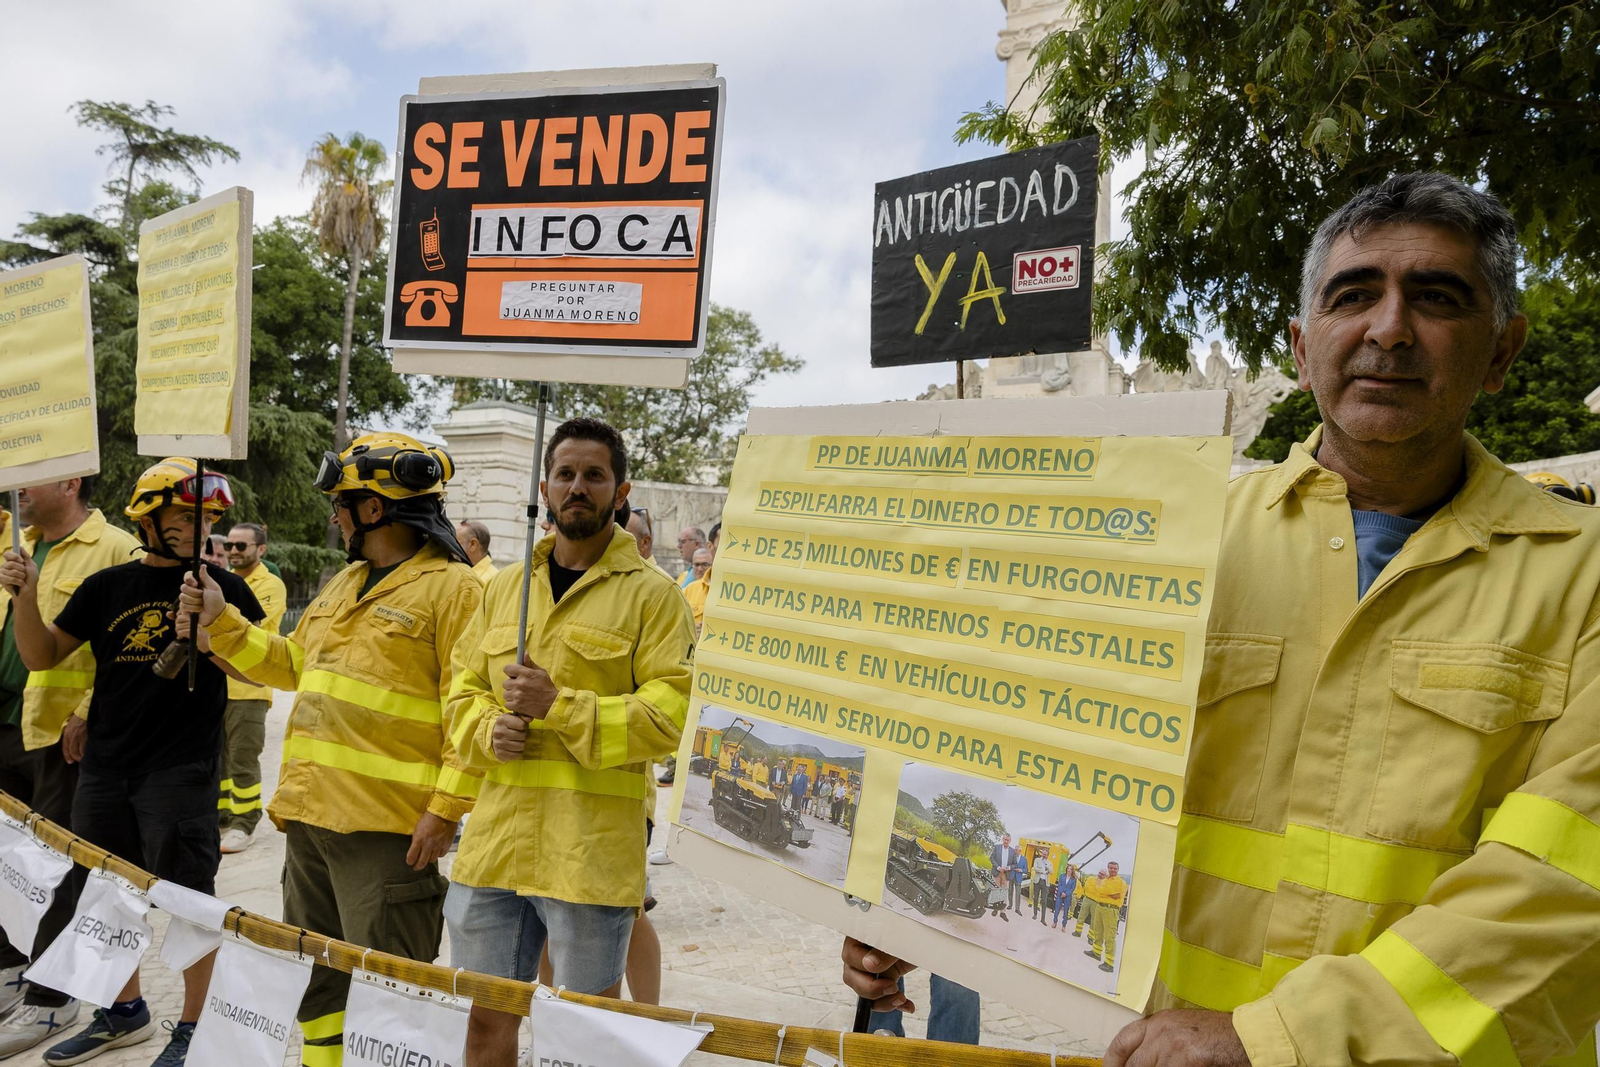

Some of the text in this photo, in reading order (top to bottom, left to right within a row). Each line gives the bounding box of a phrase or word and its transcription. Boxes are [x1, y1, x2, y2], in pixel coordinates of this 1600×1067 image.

[410, 110, 711, 191] SE VENDE
[874, 162, 1081, 248] ANTIGÜEDAD
[168, 224, 190, 241] JUANMA
[191, 214, 216, 232] MORENO
[472, 214, 694, 252] INFOCA
[145, 259, 174, 276] DESPILFARRA
[173, 257, 180, 267] EL
[180, 249, 200, 266] DINERO
[199, 247, 208, 260] DE
[1018, 256, 1074, 280] NO+
[4, 276, 44, 296] MORENO
[160, 284, 184, 300] MILLONES
[184, 284, 191, 295] DE
[196, 280, 203, 292] EN
[203, 271, 233, 289] CAMIONES
[530, 281, 616, 294] PREGUNTAR
[914, 251, 1008, 336] YA
[1017, 274, 1074, 288] PRECARIEDAD
[20, 297, 69, 317] DERECHOS:
[503, 307, 639, 322] JUANMA MORENO
[557, 295, 585, 306] POR
[149, 307, 223, 332] AUTOBOMBA CON PROBLEMAS
[206, 339, 217, 353] QUE
[0, 382, 40, 399] OVILIDAD
[142, 370, 229, 389] COMPROMETEN NUESTRA SEGURIDAD
[31, 408, 37, 418] Y
[39, 405, 51, 416] DE
[53, 396, 92, 413] CALIDAD
[816, 444, 1095, 473] PP DE JUANMA MORENO
[757, 489, 1157, 537] DESPILFARRA EL DINERO DE TOD@S:
[754, 536, 779, 558] DE
[780, 539, 803, 561] 25
[806, 542, 904, 573] MILLONES
[910, 553, 940, 577] DE
[945, 556, 960, 579] €
[966, 558, 1000, 583] EN
[1006, 562, 1202, 607] FURGONETAS
[720, 581, 1175, 669] NO APTAS PARA TERRENOS FORESTALES
[732, 630, 756, 653] DE
[758, 635, 791, 660] 800
[795, 642, 830, 668] MIL
[835, 650, 849, 672] €
[859, 653, 888, 680] EN
[894, 660, 1027, 709] VEHÍCULOS
[1039, 687, 1182, 743] TÁCTICOS
[698, 671, 1176, 813] QUE SOLO HAN SERVIDO PARA ESTA FOTO
[1, 863, 48, 904] FORESTALES
[347, 1031, 451, 1067] ANTIGÜED
